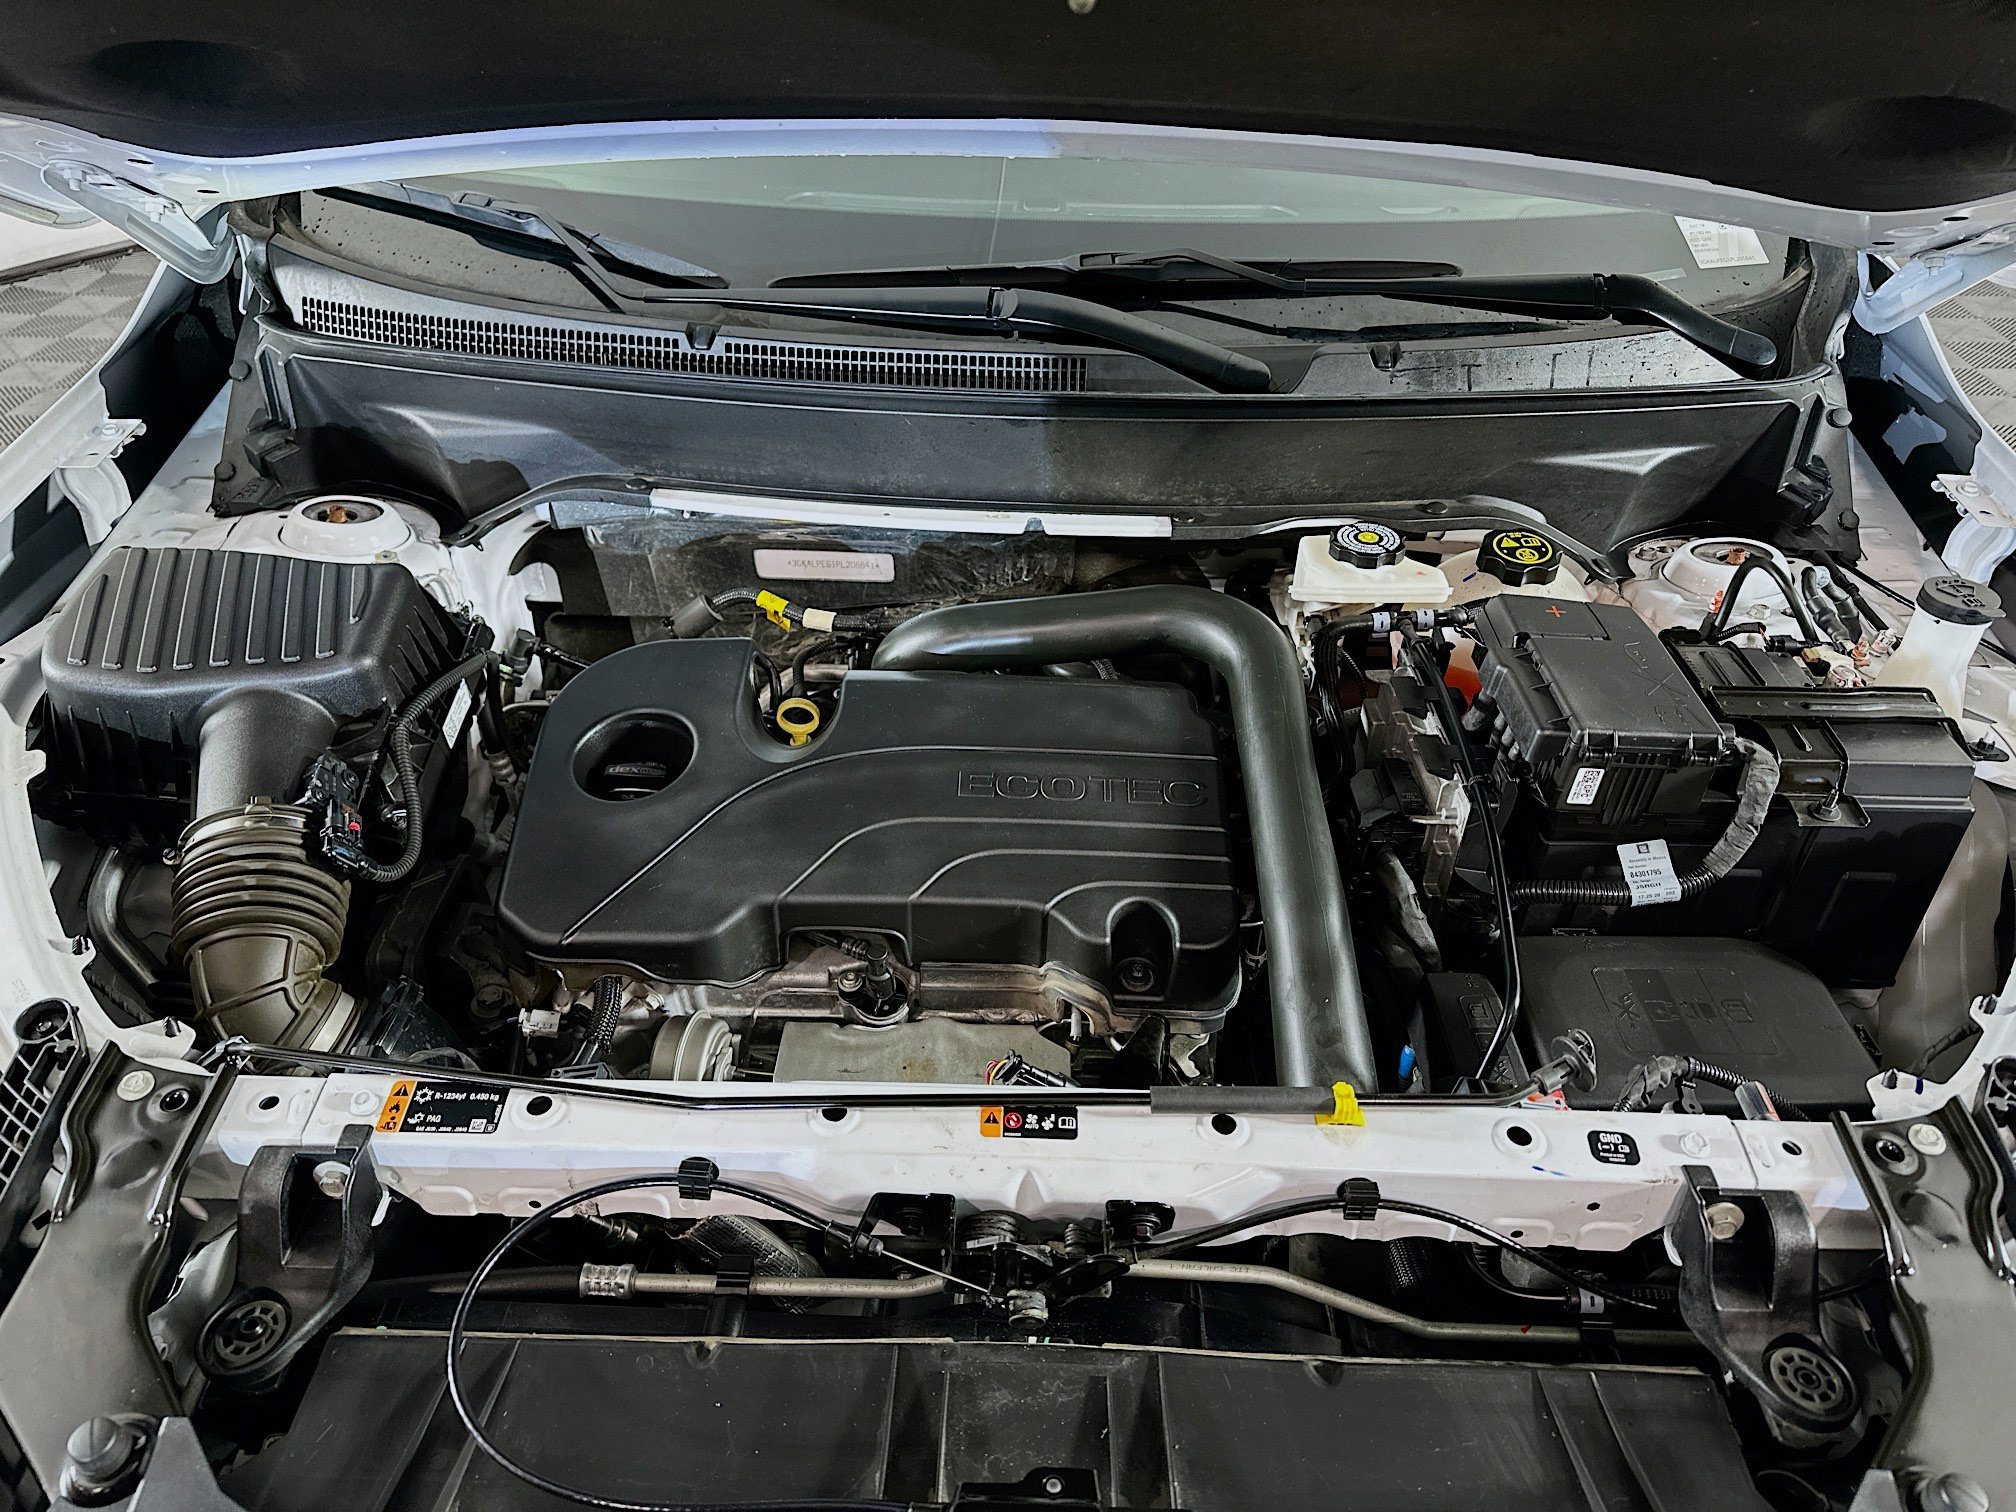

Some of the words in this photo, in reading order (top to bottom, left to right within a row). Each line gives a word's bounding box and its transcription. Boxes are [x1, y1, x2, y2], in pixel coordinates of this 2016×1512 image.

[957, 770, 1209, 807] ECOTEC
[1580, 784, 1593, 798] GPC
[434, 1092, 467, 1102] R-1234yf
[490, 1093, 500, 1102] kg
[426, 1114, 442, 1123] PAG
[1599, 1132, 1623, 1144] GND
